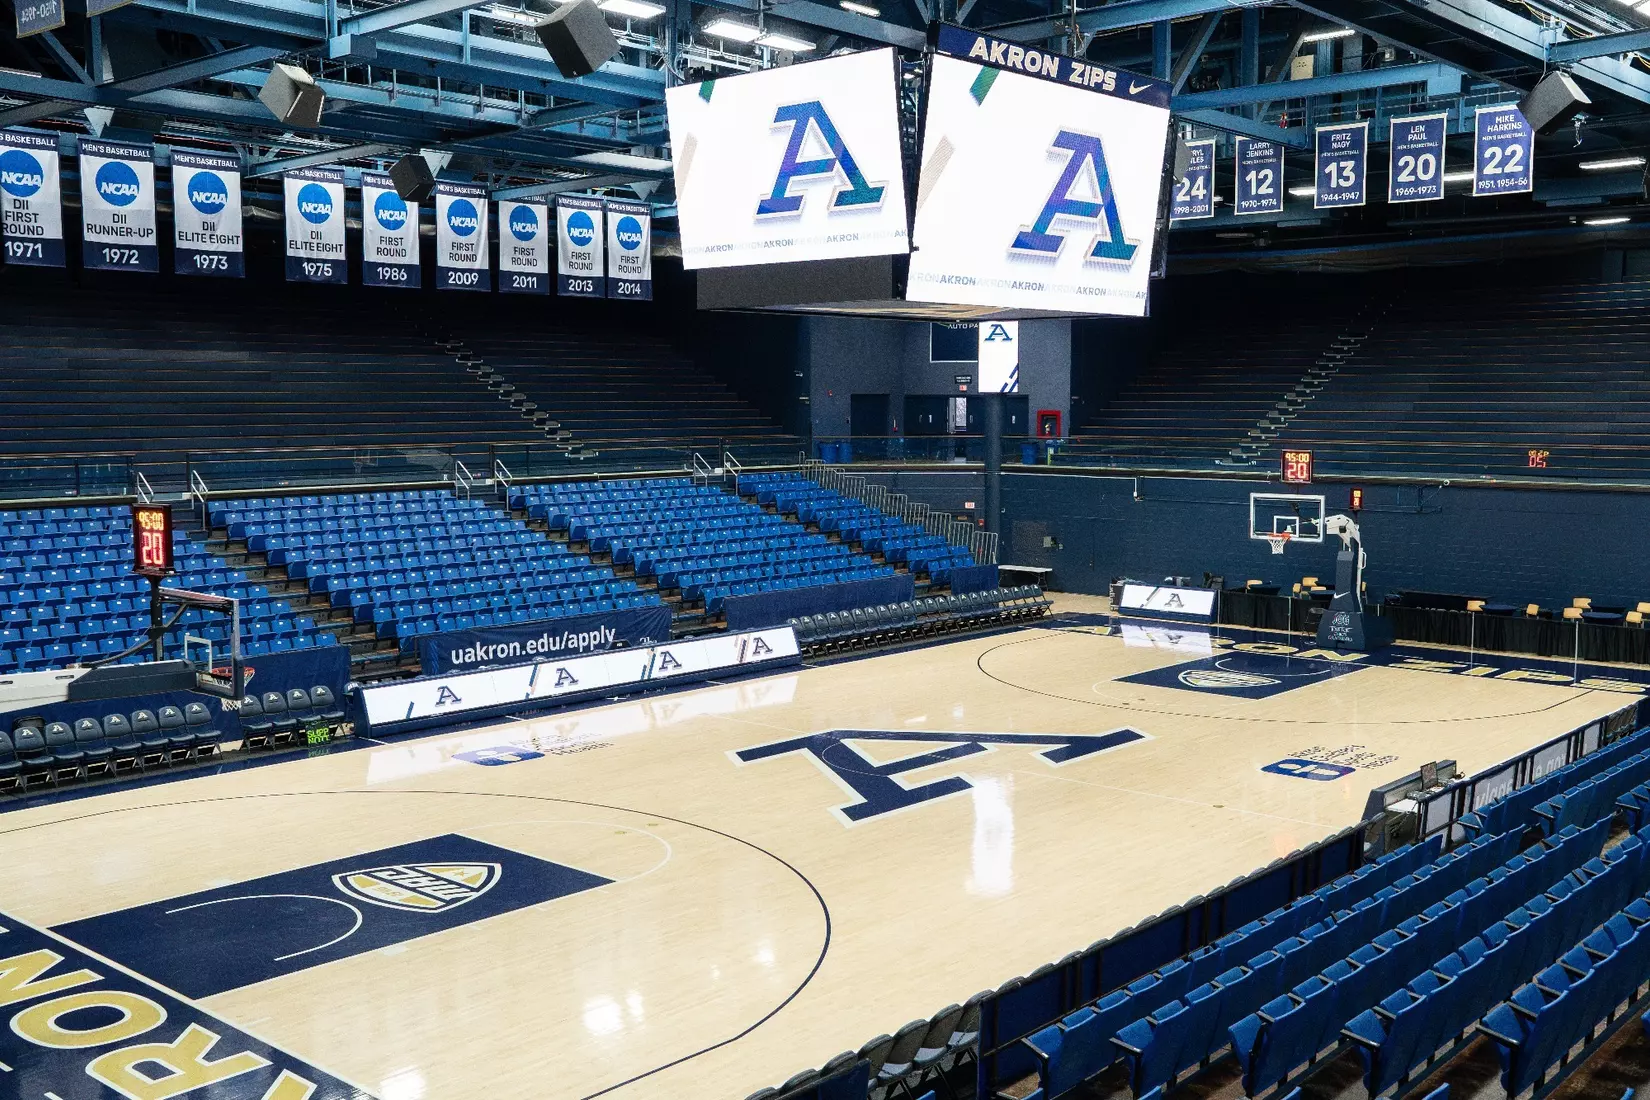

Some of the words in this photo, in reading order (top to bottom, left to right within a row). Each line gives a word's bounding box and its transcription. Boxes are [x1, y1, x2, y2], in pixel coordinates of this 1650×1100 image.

[969, 37, 1060, 77] AKRON
[1068, 62, 1117, 92] ZIPS
[1495, 115, 1515, 123] MIKE
[1411, 125, 1425, 133] LEN
[1487, 122, 1522, 132] HARKINS
[5, 134, 56, 147] BASKETBALL
[1331, 133, 1351, 141] FRITZ
[1408, 132, 1427, 141] PAUL
[82, 143, 105, 153] MEN'S
[106, 147, 151, 157] BASKETBALL
[1249, 142, 1271, 150] LARRY
[1331, 141, 1350, 149] NAGY
[754, 98, 888, 220] A
[1246, 149, 1274, 158] JENKINS
[1483, 144, 1523, 174] 22
[174, 154, 196, 164] MEN'S
[196, 157, 238, 168] BASKETBALL
[1397, 153, 1436, 182] 20
[1, 171, 42, 187] NCAA
[1324, 161, 1356, 188] 13
[1245, 169, 1274, 195] 12
[101, 182, 139, 195] NCAA
[454, 186, 486, 195] BASKETBALL
[1176, 176, 1207, 201] 24
[1395, 185, 1436, 196] 1969-1973
[192, 191, 228, 204] NCAA
[1009, 127, 1140, 263] A
[1321, 192, 1359, 202] 1944-1947
[13, 199, 29, 210] DII
[301, 202, 332, 214] NCAA
[1174, 205, 1208, 214] 1998-2001
[1241, 199, 1277, 208] 1970-1974
[5, 211, 39, 223] FIRST
[112, 214, 127, 224] DII
[378, 209, 407, 221] NCAA
[202, 221, 216, 231] DII
[450, 216, 478, 227] NCAA
[512, 222, 539, 233] NCAA
[2, 223, 44, 236] ROUND
[86, 224, 154, 238] RUNNER-UP
[569, 227, 594, 238] NCAA
[178, 231, 206, 243] ELITE
[209, 234, 240, 245] EIGHT
[379, 236, 404, 246] FIRST
[619, 232, 642, 242] NCAA
[704, 244, 734, 253] AKRON
[763, 239, 794, 248] AKRON
[826, 233, 859, 243] AKRON
[4, 241, 43, 258] 1971
[289, 240, 315, 251] ELITE
[316, 243, 344, 253] EIGHT
[376, 247, 407, 257] ROUND
[451, 241, 475, 252] FIRST
[513, 246, 535, 256] FIRST
[102, 248, 139, 264] 1972
[449, 252, 477, 263] ROUND
[571, 251, 591, 260] FIRST
[620, 256, 640, 265] FIRST
[193, 255, 228, 270] 1973
[511, 257, 538, 267] ROUND
[568, 261, 593, 271] ROUND
[302, 262, 333, 276] 1975
[376, 267, 407, 281] 1986
[618, 265, 642, 274] ROUND
[448, 271, 479, 285] 2009
[512, 275, 537, 289] 2011
[568, 279, 593, 292] 2013
[617, 282, 641, 295] 2014
[939, 275, 976, 286] AKRON
[1011, 281, 1045, 292] AKRON
[1075, 286, 1106, 296] AKRON
[1287, 463, 1307, 479] 20
[142, 532, 164, 565] 20
[451, 625, 616, 665] uakron.edu/apply
